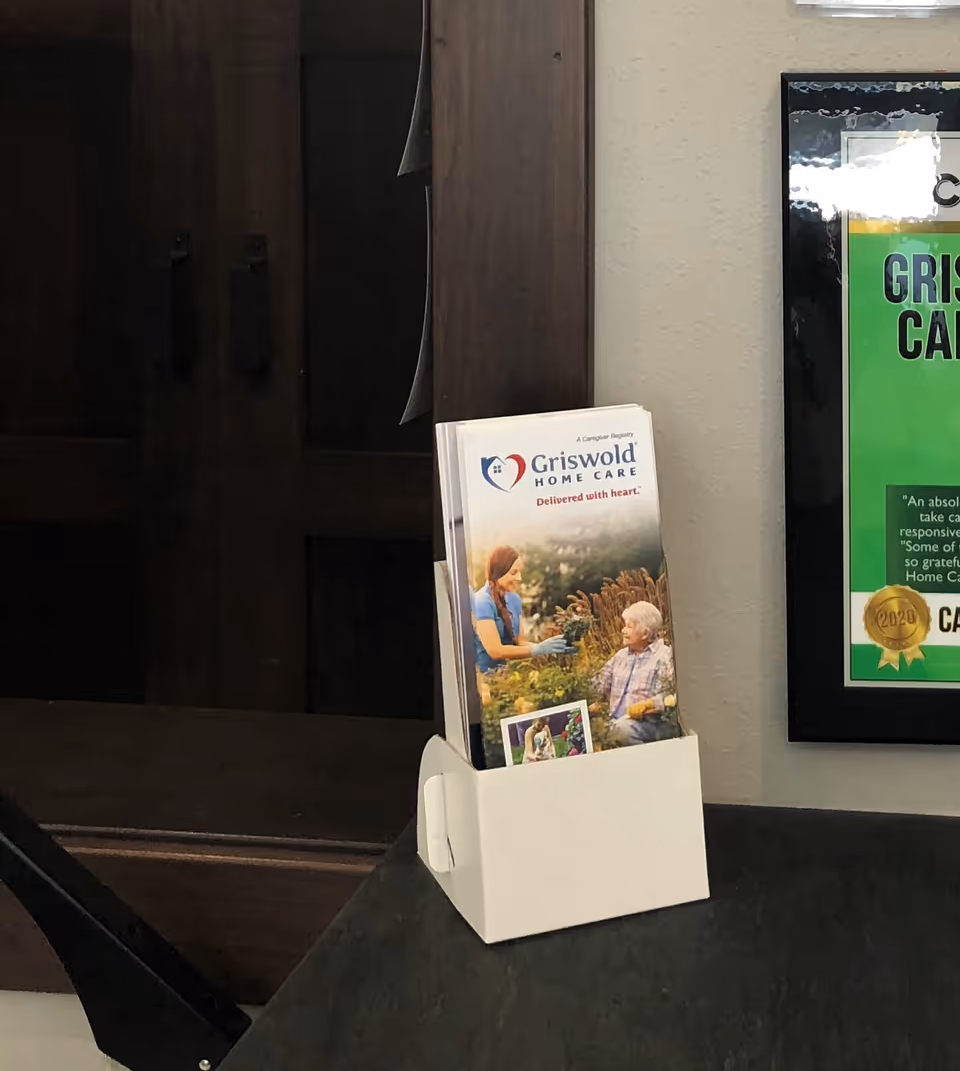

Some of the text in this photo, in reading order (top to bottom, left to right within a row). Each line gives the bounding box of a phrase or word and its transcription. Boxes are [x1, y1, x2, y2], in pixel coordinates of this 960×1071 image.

[531, 443, 636, 473] Griswold
[535, 467, 637, 487] HOME CARE
[536, 487, 640, 506] Delivered with heart.
[920, 512, 944, 522] take
[943, 541, 956, 552] of
[905, 559, 918, 567] so
[906, 571, 943, 582] Home
[880, 610, 915, 628] 2020
